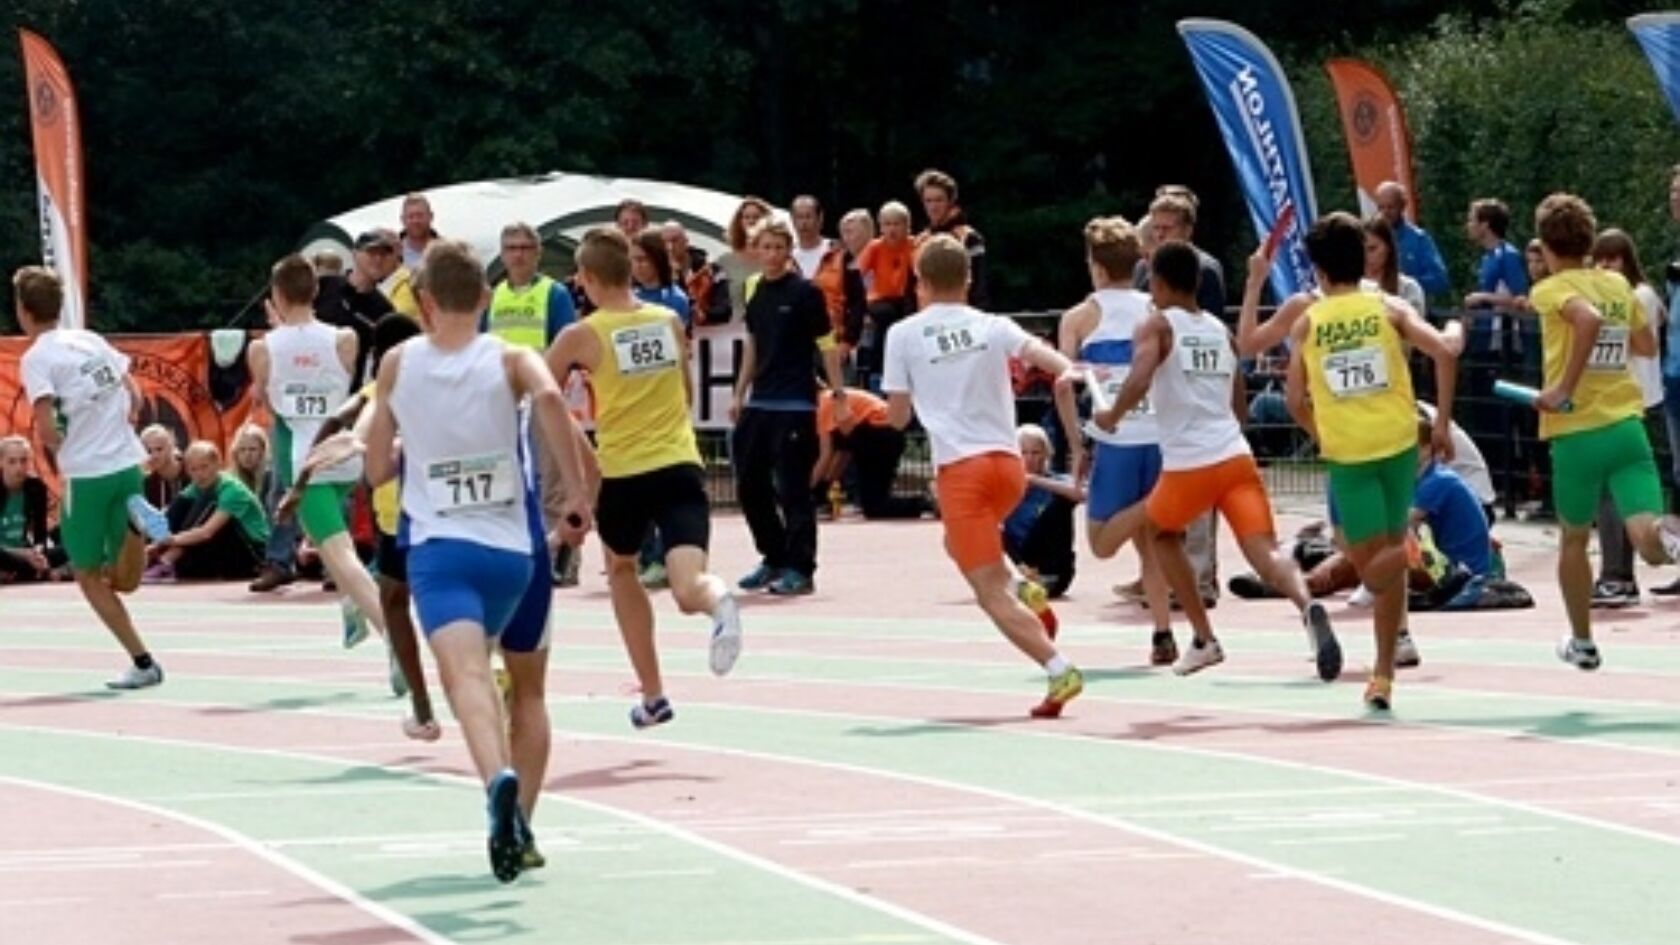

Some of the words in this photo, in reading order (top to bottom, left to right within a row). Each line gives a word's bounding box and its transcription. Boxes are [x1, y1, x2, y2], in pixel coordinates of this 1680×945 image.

[1315, 315, 1380, 347] HAAG
[630, 339, 665, 364] 652
[1192, 349, 1219, 371] 817
[1595, 343, 1623, 362] 777
[1337, 362, 1375, 388] 776
[295, 396, 327, 415] 873
[446, 472, 493, 505] 717
